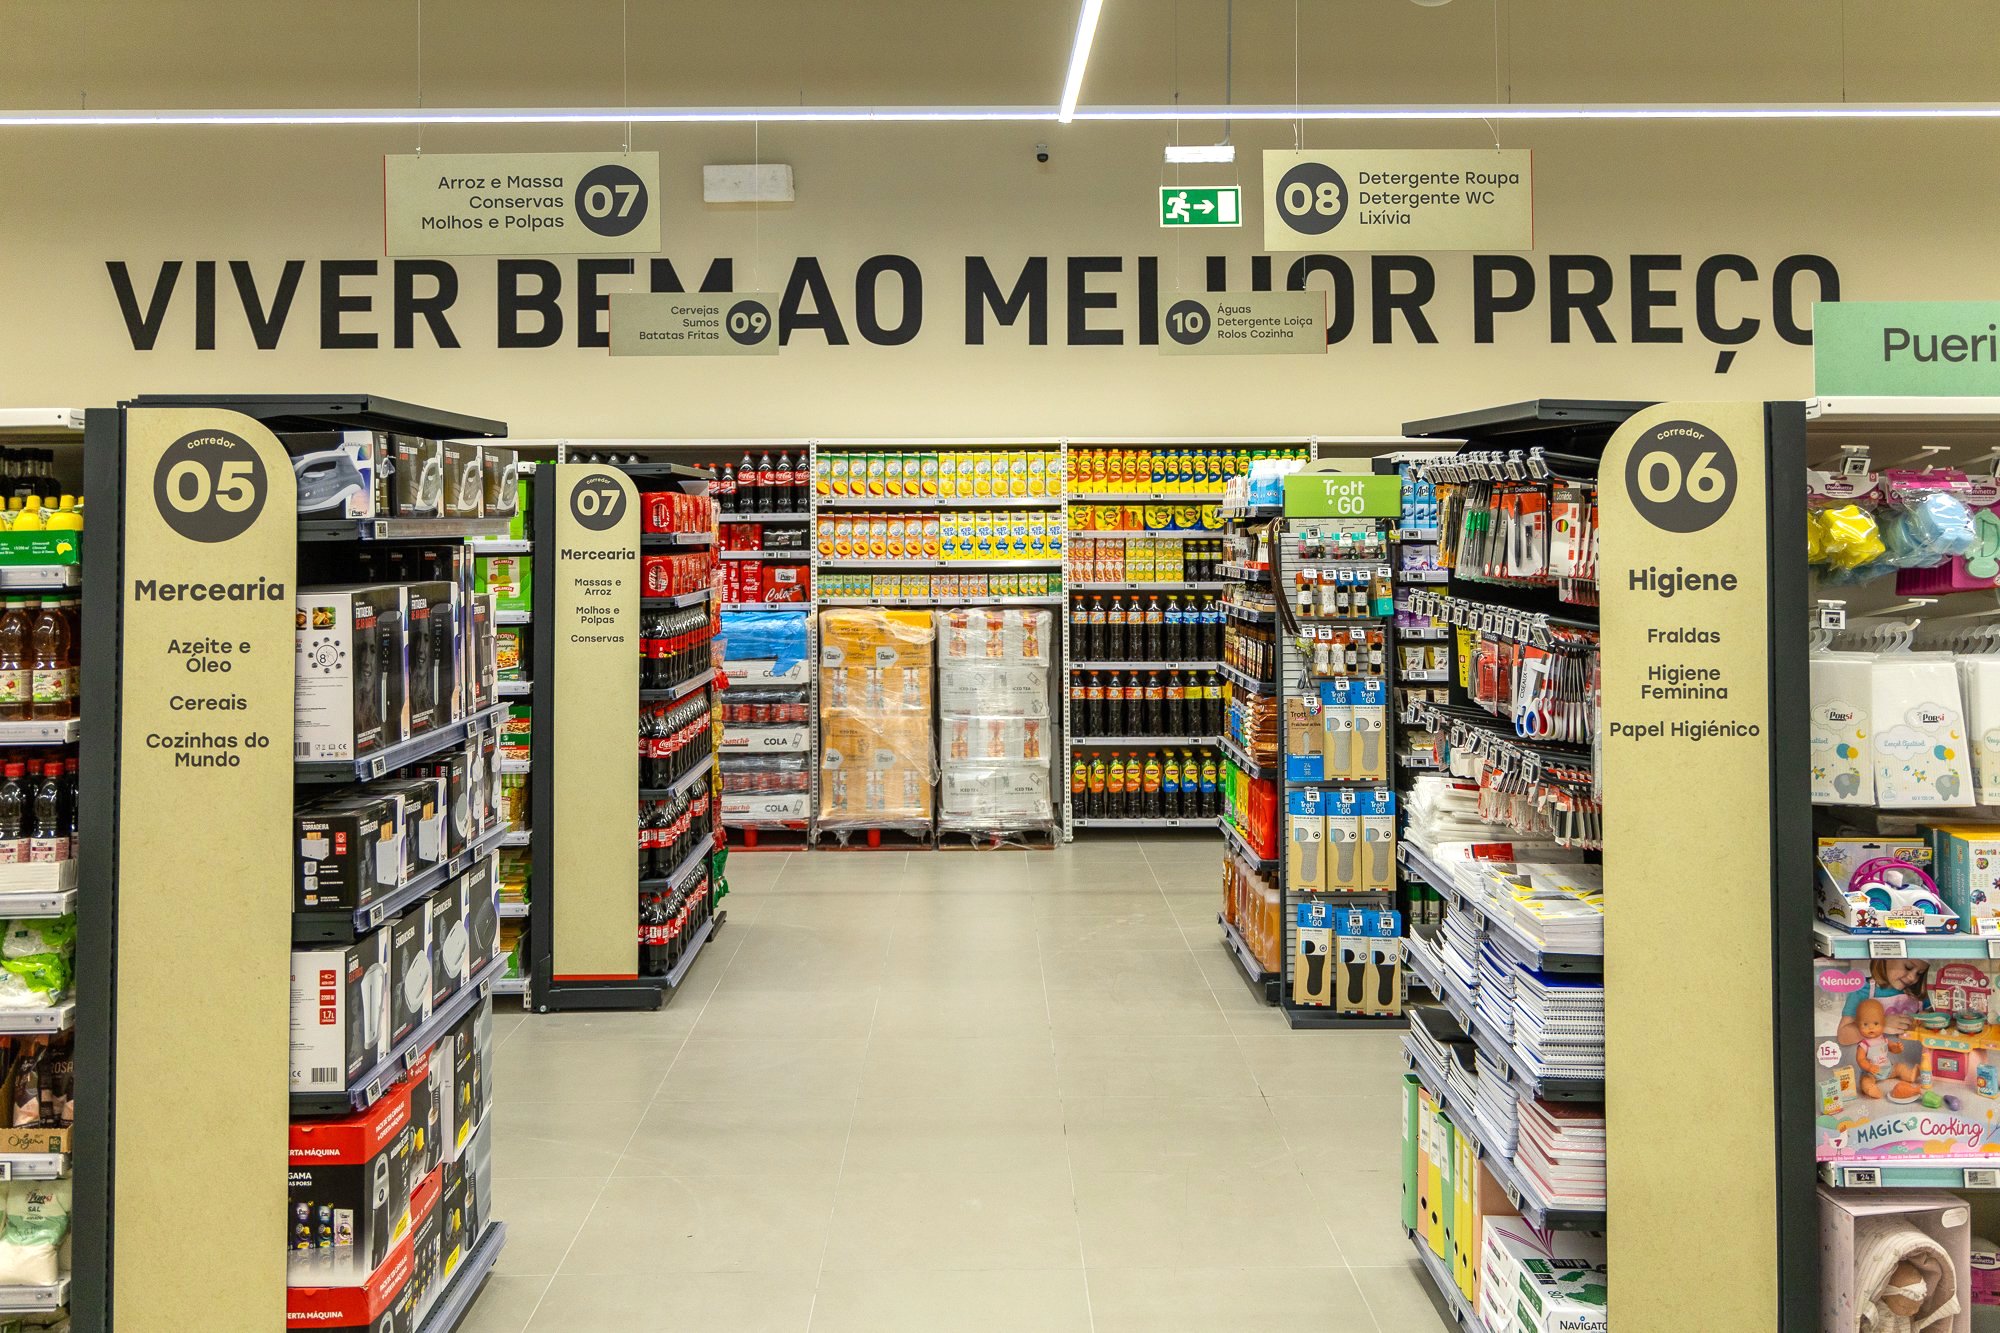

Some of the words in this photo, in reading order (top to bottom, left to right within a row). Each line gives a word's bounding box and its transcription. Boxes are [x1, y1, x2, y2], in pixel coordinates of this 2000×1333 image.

[439, 176, 485, 190] Arroz
[491, 178, 501, 188] e
[507, 175, 563, 188] Massa
[1360, 171, 1460, 187] Detergente
[1465, 172, 1519, 188] Roupa
[470, 194, 563, 209] Conservas
[584, 185, 639, 217] 07
[1284, 183, 1341, 216] 08
[1360, 191, 1460, 206] Detergente
[1466, 191, 1495, 204] WC
[422, 216, 482, 230] Molhos
[489, 218, 499, 228] e
[505, 215, 564, 231] Polpas
[1360, 211, 1410, 225] Lixívia
[106, 259, 460, 350] VIVER
[778, 254, 924, 347] AO
[1473, 253, 1840, 373] PREÇO
[671, 306, 719, 317] Cervejas
[1218, 304, 1251, 316] Águas
[683, 319, 719, 328] Sumos
[731, 312, 766, 333] 09
[1172, 312, 1203, 333] 10
[1218, 317, 1280, 328] Detergente
[1285, 316, 1312, 327] Loiça
[640, 331, 684, 340] Batatas
[688, 330, 719, 339] Fritas
[1218, 330, 1248, 338] Rolos
[1251, 329, 1293, 338] Cozinha
[1884, 324, 1996, 362] Pueri
[1657, 428, 1704, 441] corredor
[187, 436, 236, 449] corredor
[1638, 451, 1725, 503] 06
[166, 460, 255, 513] 05
[1323, 480, 1364, 495] Trott
[577, 490, 620, 516] 07
[1338, 497, 1364, 514] GO
[561, 548, 635, 560] Mercearia
[135, 577, 284, 601] Mercearia
[1629, 567, 1738, 598] Higiene
[581, 616, 614, 625] Polpas
[1648, 628, 1720, 643] Fraldas
[168, 638, 232, 653] Azeite
[239, 642, 250, 653] e
[186, 653, 231, 672] Óleo
[1648, 666, 1720, 685] Higiene
[1641, 684, 1727, 699] Feminina
[170, 694, 247, 710] Cereais
[1610, 722, 1664, 741] Papel
[1671, 720, 1760, 741] Higiénico
[146, 733, 237, 748] Cozinhas
[245, 733, 269, 748] do
[176, 751, 240, 767] Mundo
[1821, 977, 1861, 986] Nenuco
[304, 1148, 340, 1157] MÁQUINA
[306, 1310, 343, 1320] MÁQUINA
